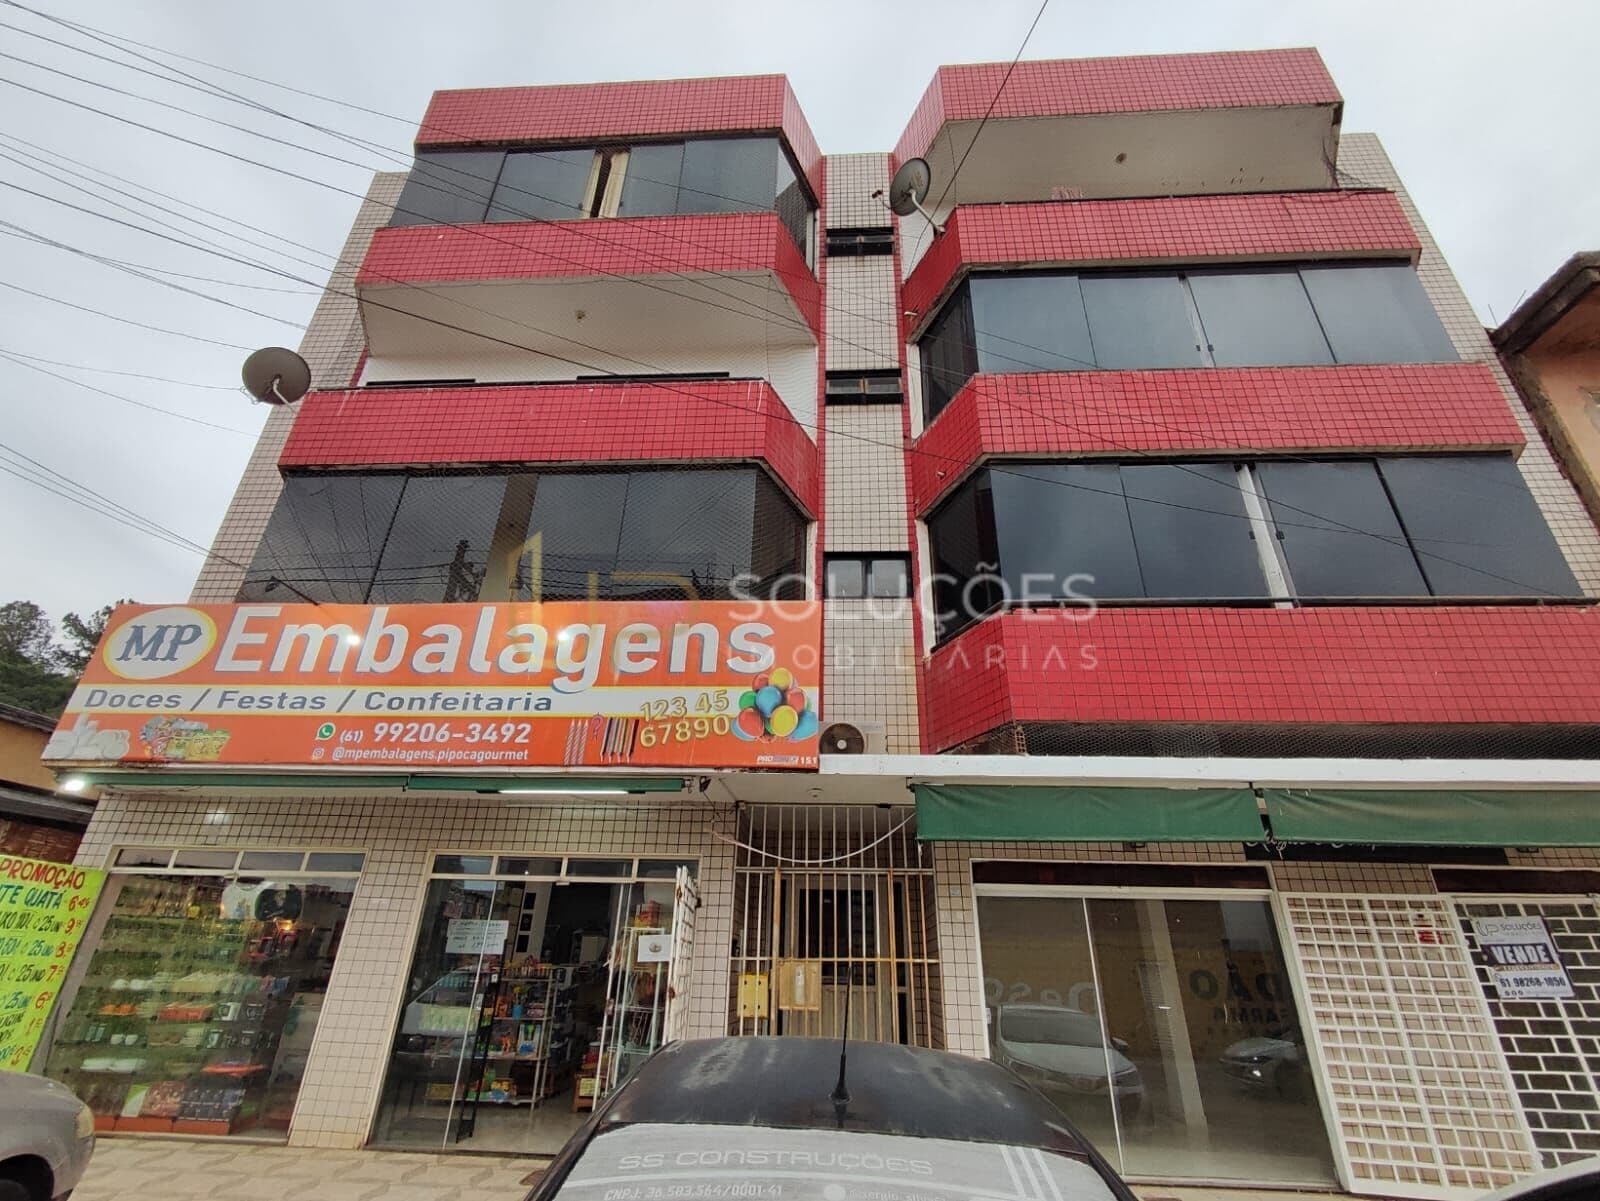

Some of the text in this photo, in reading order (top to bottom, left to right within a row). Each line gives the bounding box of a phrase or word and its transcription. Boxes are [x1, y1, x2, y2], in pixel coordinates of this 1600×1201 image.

[115, 624, 202, 662] MP
[214, 606, 775, 693] Embalagens
[84, 688, 552, 713] Doces / Festas / Confeitaria
[340, 722, 532, 743] (61) 99206-3492
[332, 746, 529, 762] @mpembalagens.pipocagourmet
[1490, 945, 1550, 964] VENDE
[618, 1154, 665, 1169] SS
